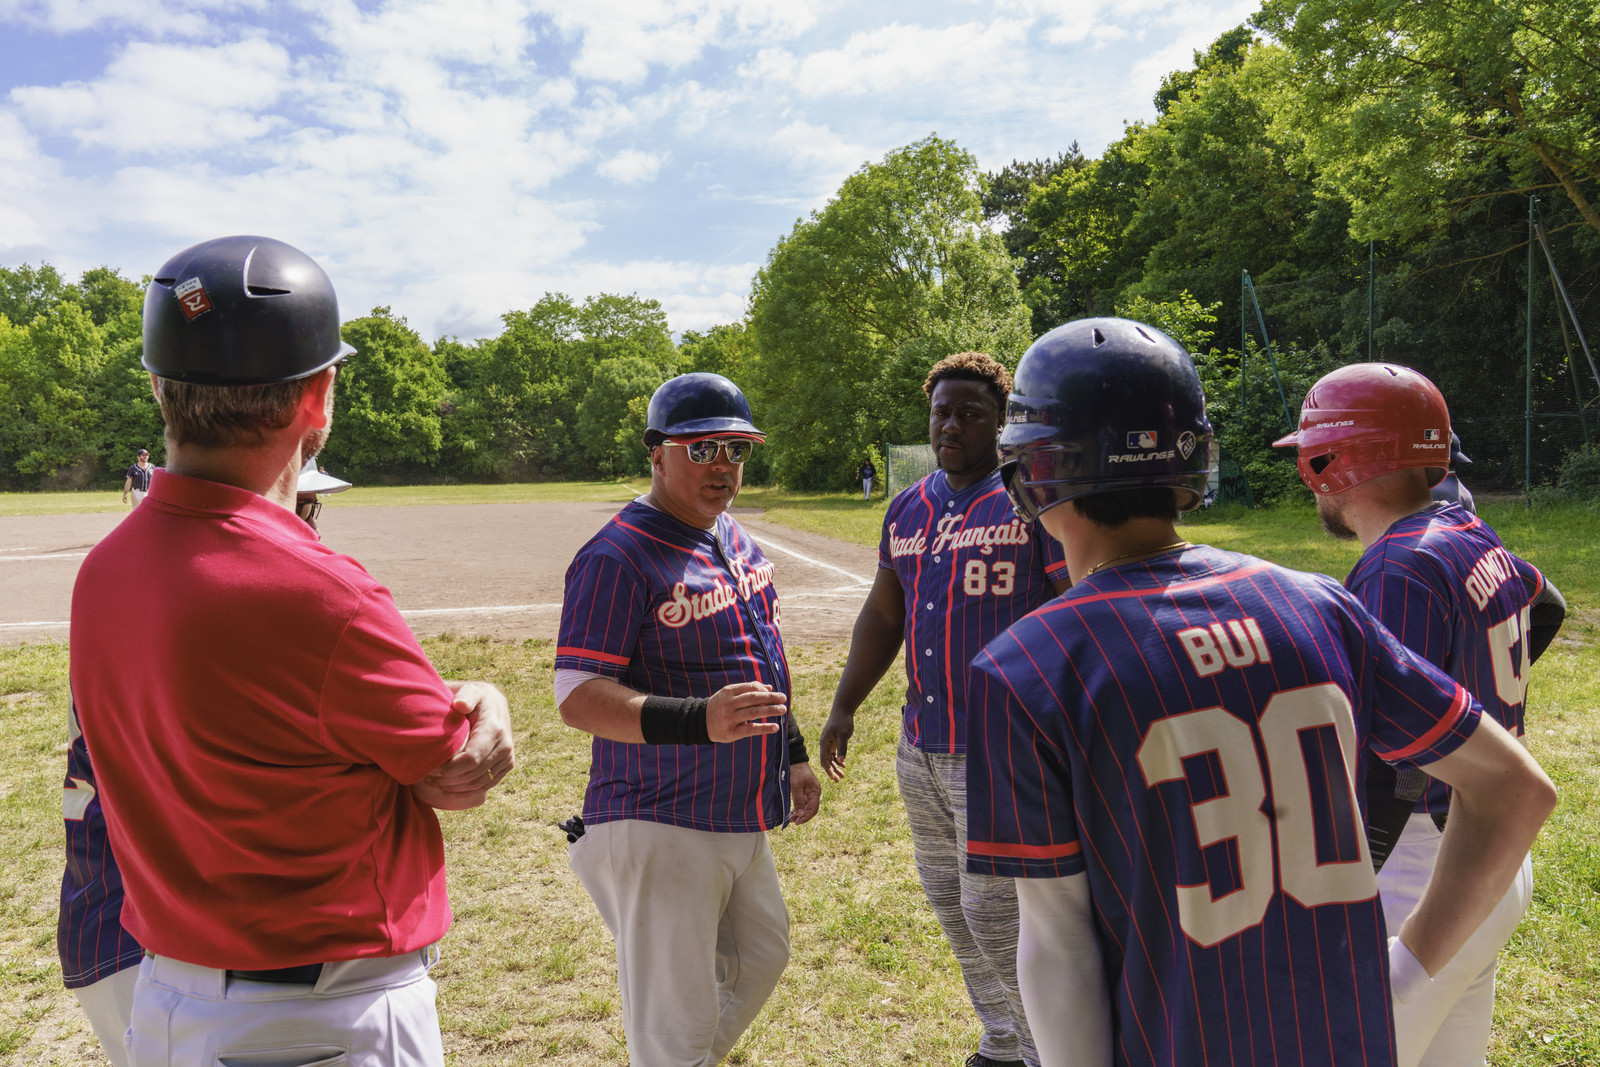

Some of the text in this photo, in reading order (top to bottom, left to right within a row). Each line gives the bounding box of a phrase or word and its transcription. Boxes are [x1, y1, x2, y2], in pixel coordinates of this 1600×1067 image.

[1316, 420, 1355, 429] RAWLINGS
[1108, 450, 1175, 463] RAWLINGS
[932, 513, 1029, 555] Français
[963, 559, 1015, 596] 83
[657, 578, 737, 628] Stade
[1176, 617, 1272, 677] BUI
[1135, 681, 1379, 948] 30
